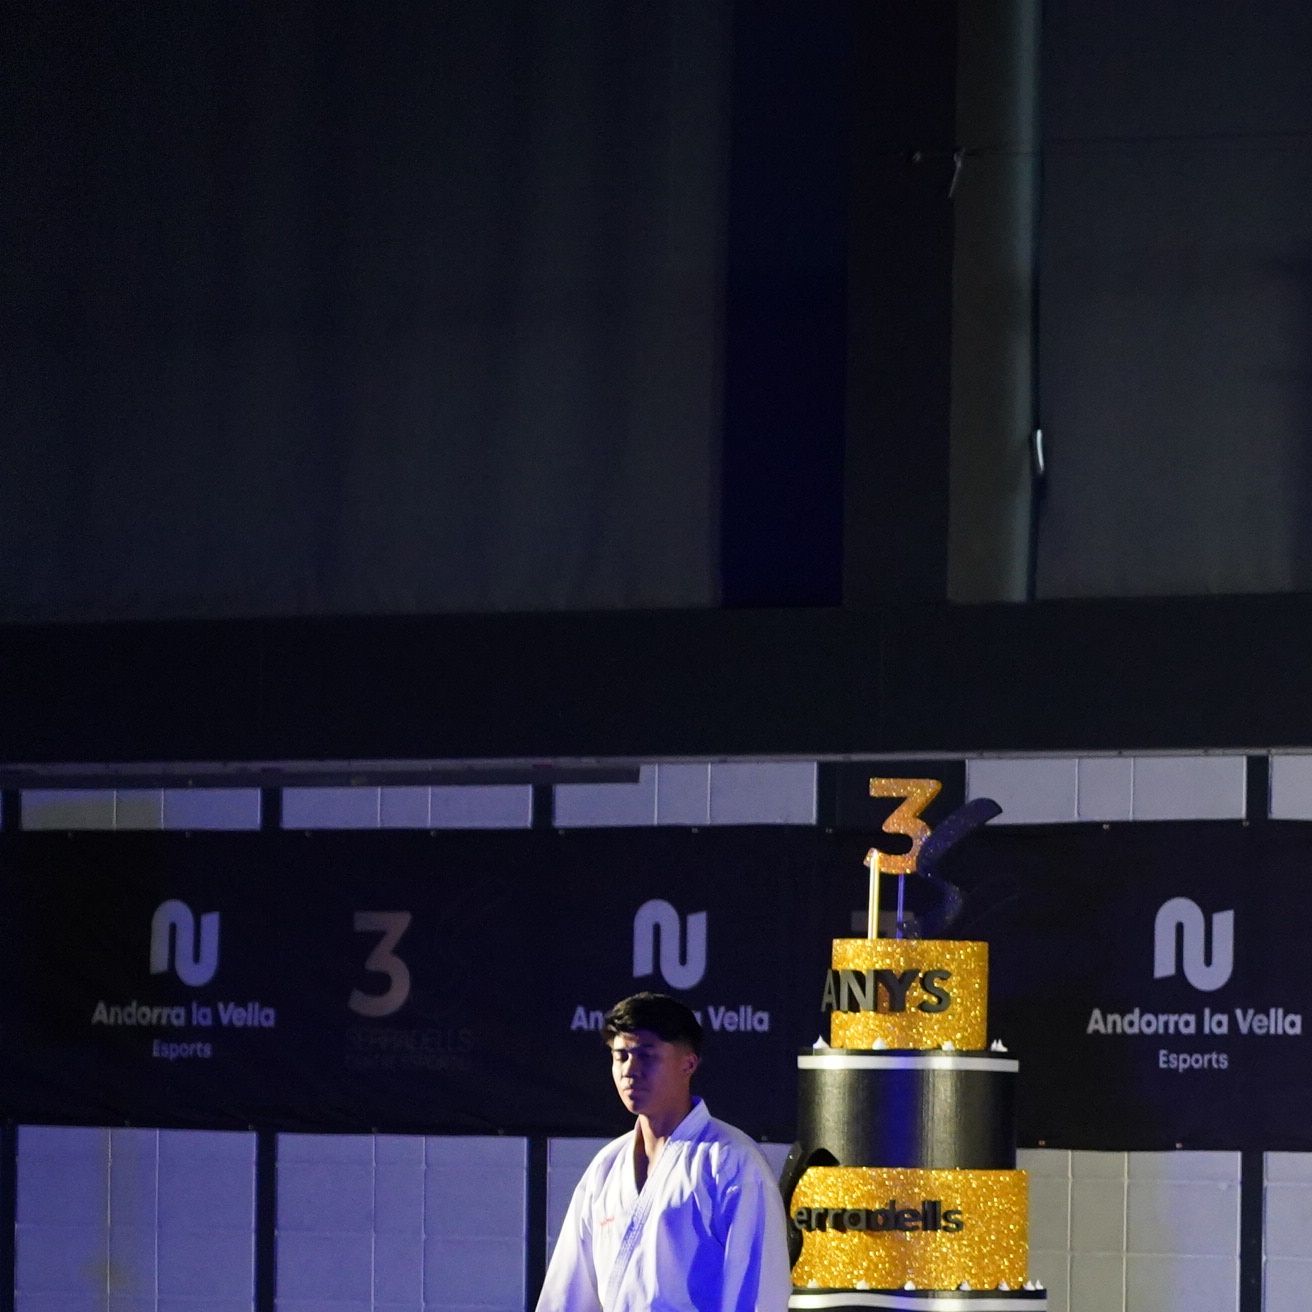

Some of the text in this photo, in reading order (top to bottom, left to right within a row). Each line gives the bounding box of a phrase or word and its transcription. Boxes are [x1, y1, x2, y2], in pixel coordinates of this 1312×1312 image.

[347, 910, 413, 1018] 3
[821, 968, 951, 1013] ANYS
[90, 1000, 276, 1028] Andorra la Vella
[706, 1005, 770, 1033] Vella
[1086, 1007, 1302, 1035] Andorra la Vella
[152, 1039, 213, 1061] Esports
[1157, 1049, 1229, 1073] Esports
